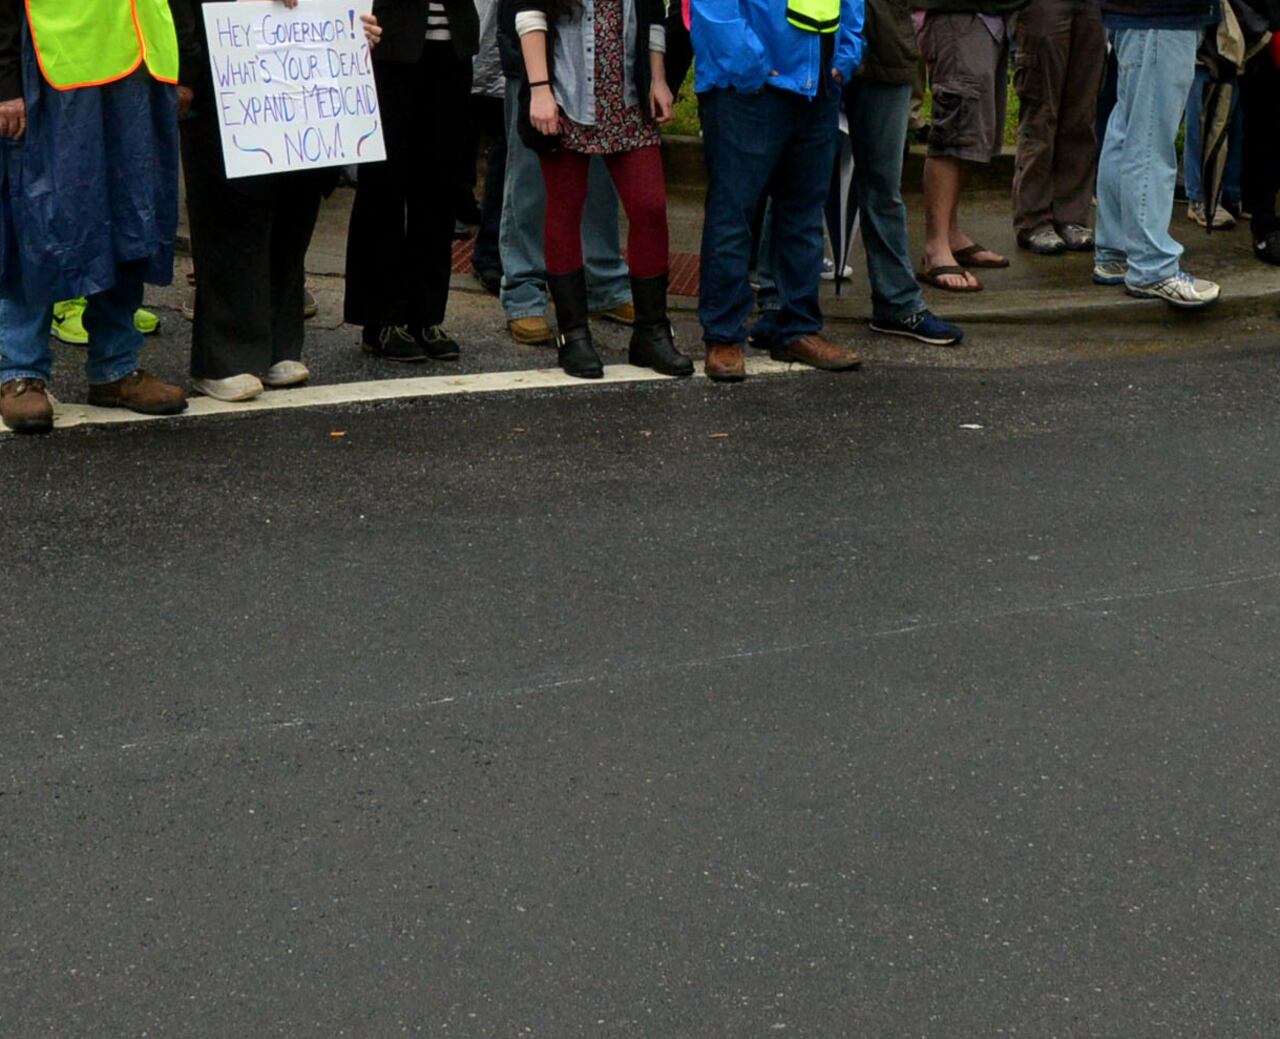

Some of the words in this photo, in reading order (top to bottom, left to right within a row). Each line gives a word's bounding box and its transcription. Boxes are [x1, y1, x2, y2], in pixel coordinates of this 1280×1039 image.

[216, 16, 251, 49] HEY
[213, 55, 272, 87] WHAT'S
[275, 49, 319, 81] YOUR
[327, 43, 371, 79] DEAL?
[221, 91, 295, 126] EXPAND
[303, 84, 377, 121] MEDICAID
[284, 122, 345, 165] NOW!
